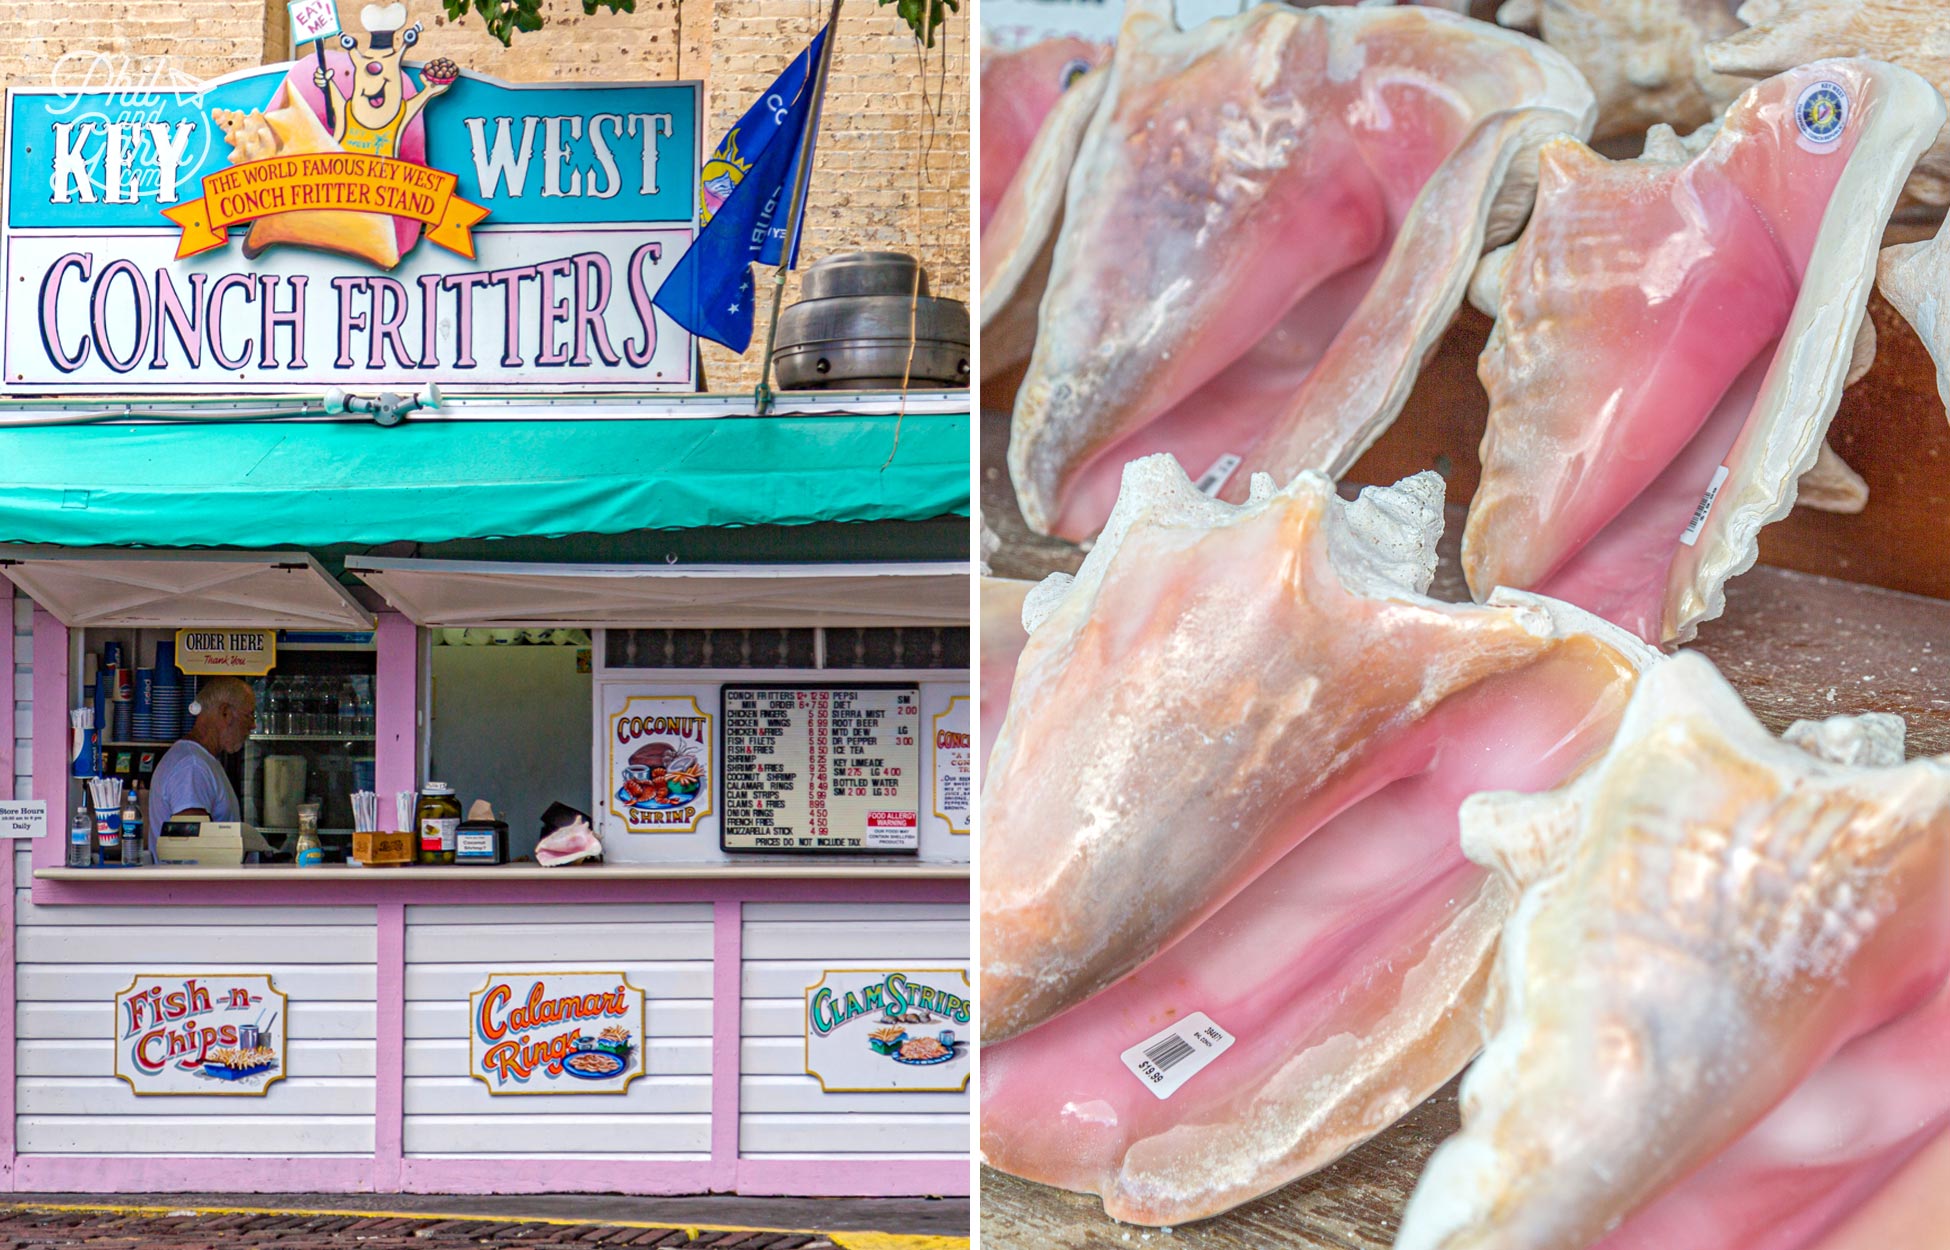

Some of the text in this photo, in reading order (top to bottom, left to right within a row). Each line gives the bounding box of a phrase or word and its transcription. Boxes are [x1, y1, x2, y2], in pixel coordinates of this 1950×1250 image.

[295, 0, 323, 26] EAT
[49, 112, 674, 204] KEY WEST
[208, 158, 446, 196] THE WORLD FAMOUS KEY WEST
[219, 182, 436, 219] CONCH FRITTER STAND
[37, 241, 664, 374] CONCH FRITTERS
[185, 633, 265, 652] ORDER HERE
[204, 655, 246, 666] Thank You
[728, 692, 754, 700] CONCH
[757, 692, 795, 700] FRITTERS
[833, 692, 858, 700] PEPSI
[898, 696, 911, 704] SM
[770, 701, 795, 709] ORDER
[833, 701, 851, 709] DIET
[727, 710, 757, 718] CHICKEN
[760, 710, 788, 718] FINGERS
[832, 710, 885, 718] SIERRA MIST
[727, 719, 758, 727] CHICKEN
[768, 719, 791, 727] WINGS
[832, 719, 879, 727] ROOT BEER
[617, 715, 707, 744] COCONUT
[727, 728, 757, 736] CHICKEN
[853, 728, 871, 736] DEW
[898, 726, 908, 734] LG
[728, 737, 745, 745] FISH
[749, 737, 775, 745] FILETS
[832, 737, 877, 745] DR PEPPER
[728, 746, 745, 754] FISH
[753, 746, 774, 754] FRIES
[833, 746, 864, 754] ICE TEA
[727, 755, 757, 763] SHRIMP
[833, 759, 884, 767] KEY LIMEADE
[727, 764, 756, 772] SHRIMP
[764, 764, 784, 772] FRIES
[834, 768, 846, 776] SM
[871, 768, 880, 776] LG
[727, 773, 760, 781] COCONUT
[767, 773, 796, 781] SHRIMP
[727, 782, 764, 790] CALAMARI
[770, 782, 793, 790] RINGS
[833, 779, 899, 787] BOTTLED WATER
[727, 791, 747, 799] CLAM
[753, 791, 780, 799] STRIPS
[833, 788, 845, 796] SM
[873, 788, 882, 796] LG
[727, 800, 753, 808] CLAMS
[766, 800, 785, 808] FRIES
[21, 807, 45, 815] Hours
[727, 809, 750, 817] ONION
[753, 809, 774, 817] RINGS
[629, 806, 696, 825] SHRIMP
[727, 818, 753, 826] FRENCH
[755, 818, 774, 826] FRIES
[876, 819, 907, 827] WARNING
[727, 827, 771, 835] MOZZARELLA
[773, 827, 793, 835] STICK
[755, 838, 861, 846] PRICES DO NOT INCLUDE TAX
[810, 972, 970, 1038] CLAM STRIPS
[123, 979, 263, 1041] Fish -n-
[476, 981, 630, 1046] Calamari
[131, 1019, 239, 1077] Chips
[482, 1027, 581, 1087] Rings
[1138, 1060, 1164, 1083] $19.99
